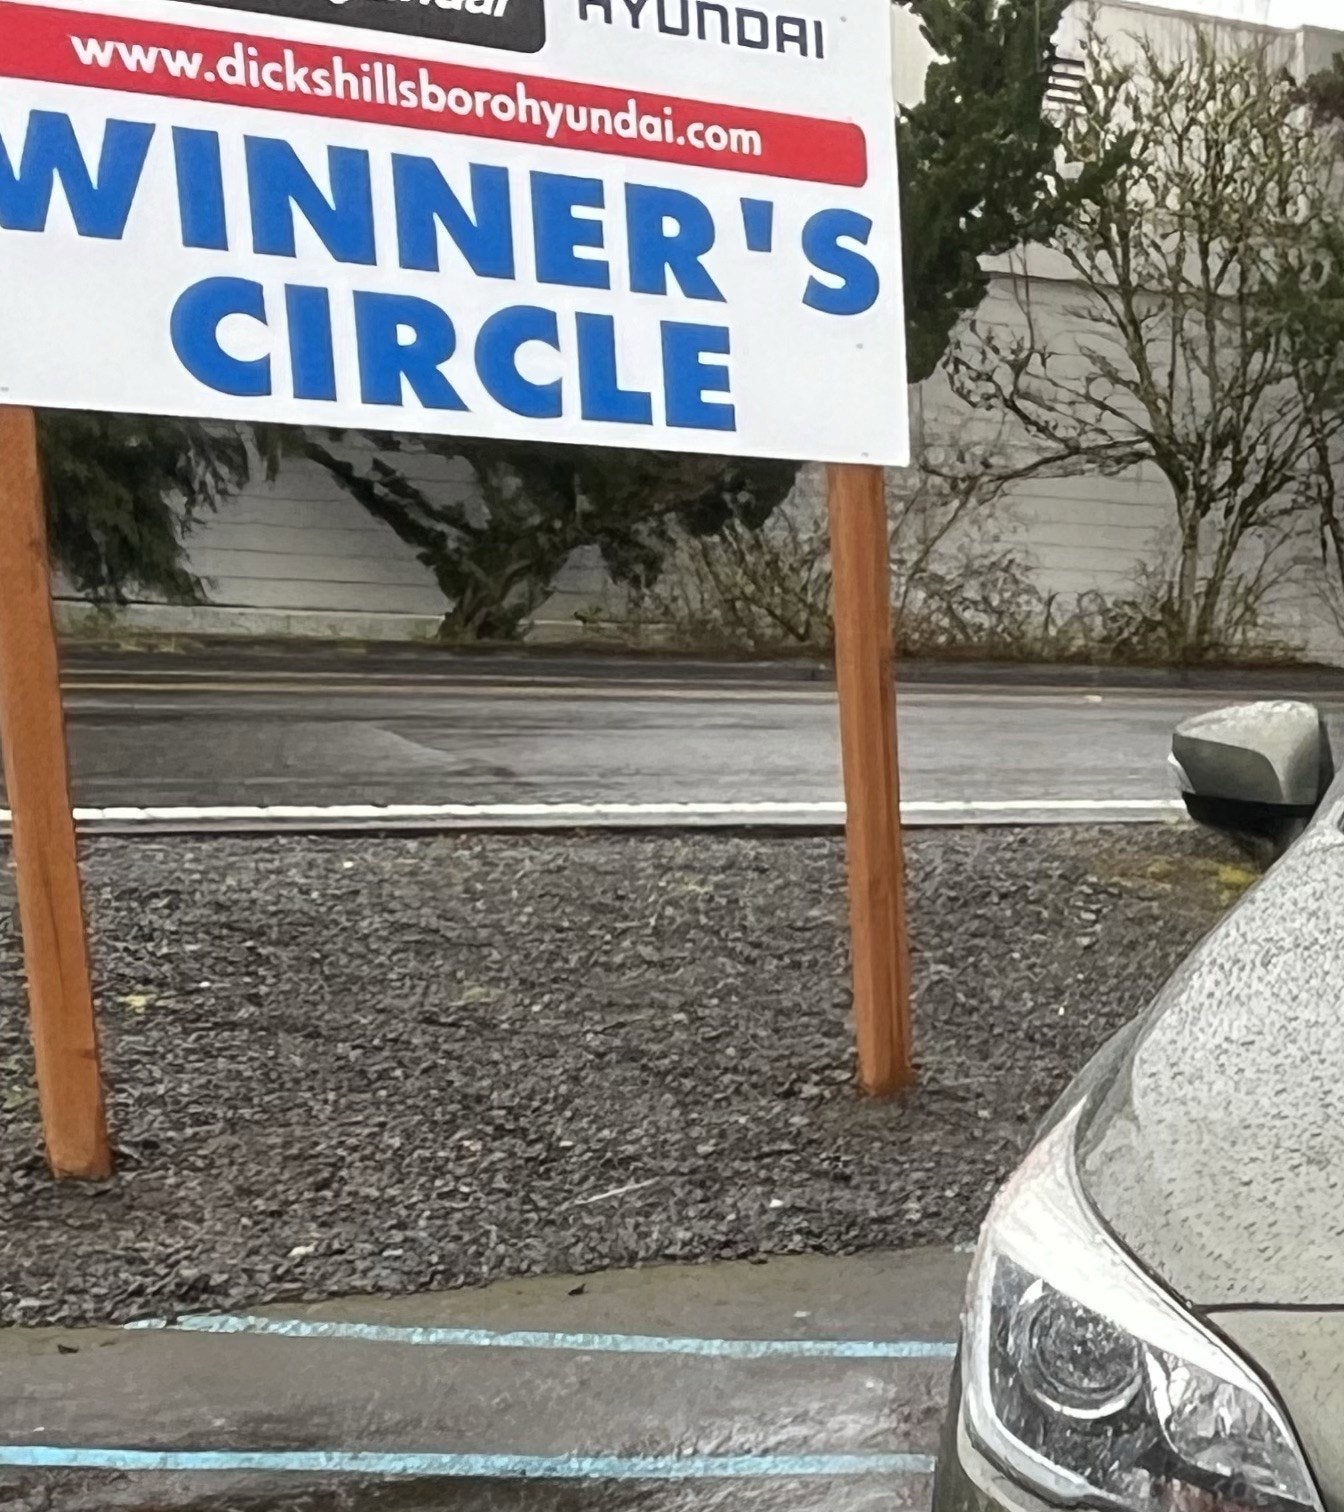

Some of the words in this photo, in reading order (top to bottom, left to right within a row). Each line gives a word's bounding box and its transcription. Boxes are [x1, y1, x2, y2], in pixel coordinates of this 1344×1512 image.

[70, 33, 762, 158] www.dickshillsborohyundai.com
[579, 0, 824, 59] HYUNDAI
[0, 108, 880, 316] WINNER'S
[170, 276, 736, 432] CIRCLE
